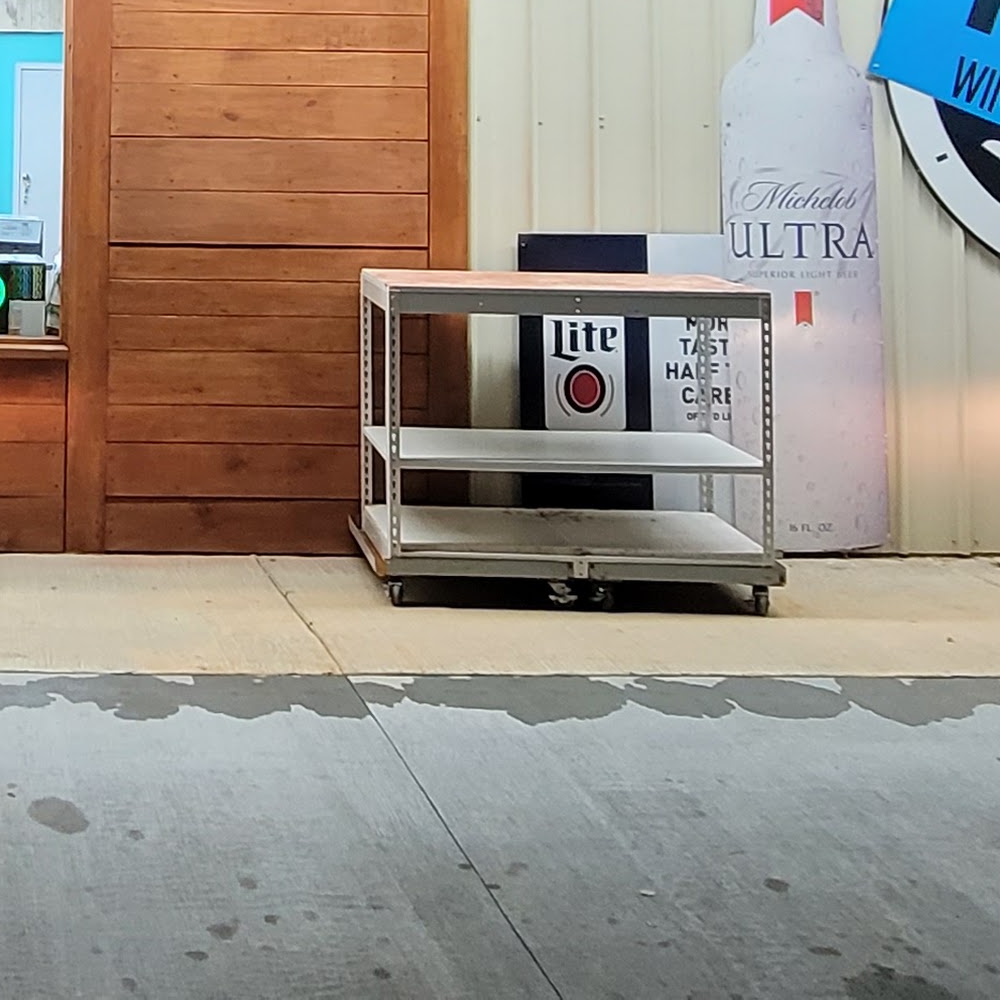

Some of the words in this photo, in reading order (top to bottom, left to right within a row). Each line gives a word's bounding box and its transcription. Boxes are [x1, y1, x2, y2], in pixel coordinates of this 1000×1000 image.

[951, 55, 1000, 113] WI
[742, 181, 857, 211] Michelob
[729, 222, 874, 259] ULTRA
[800, 270, 832, 279] LIGHT
[550, 319, 617, 361] Lite
